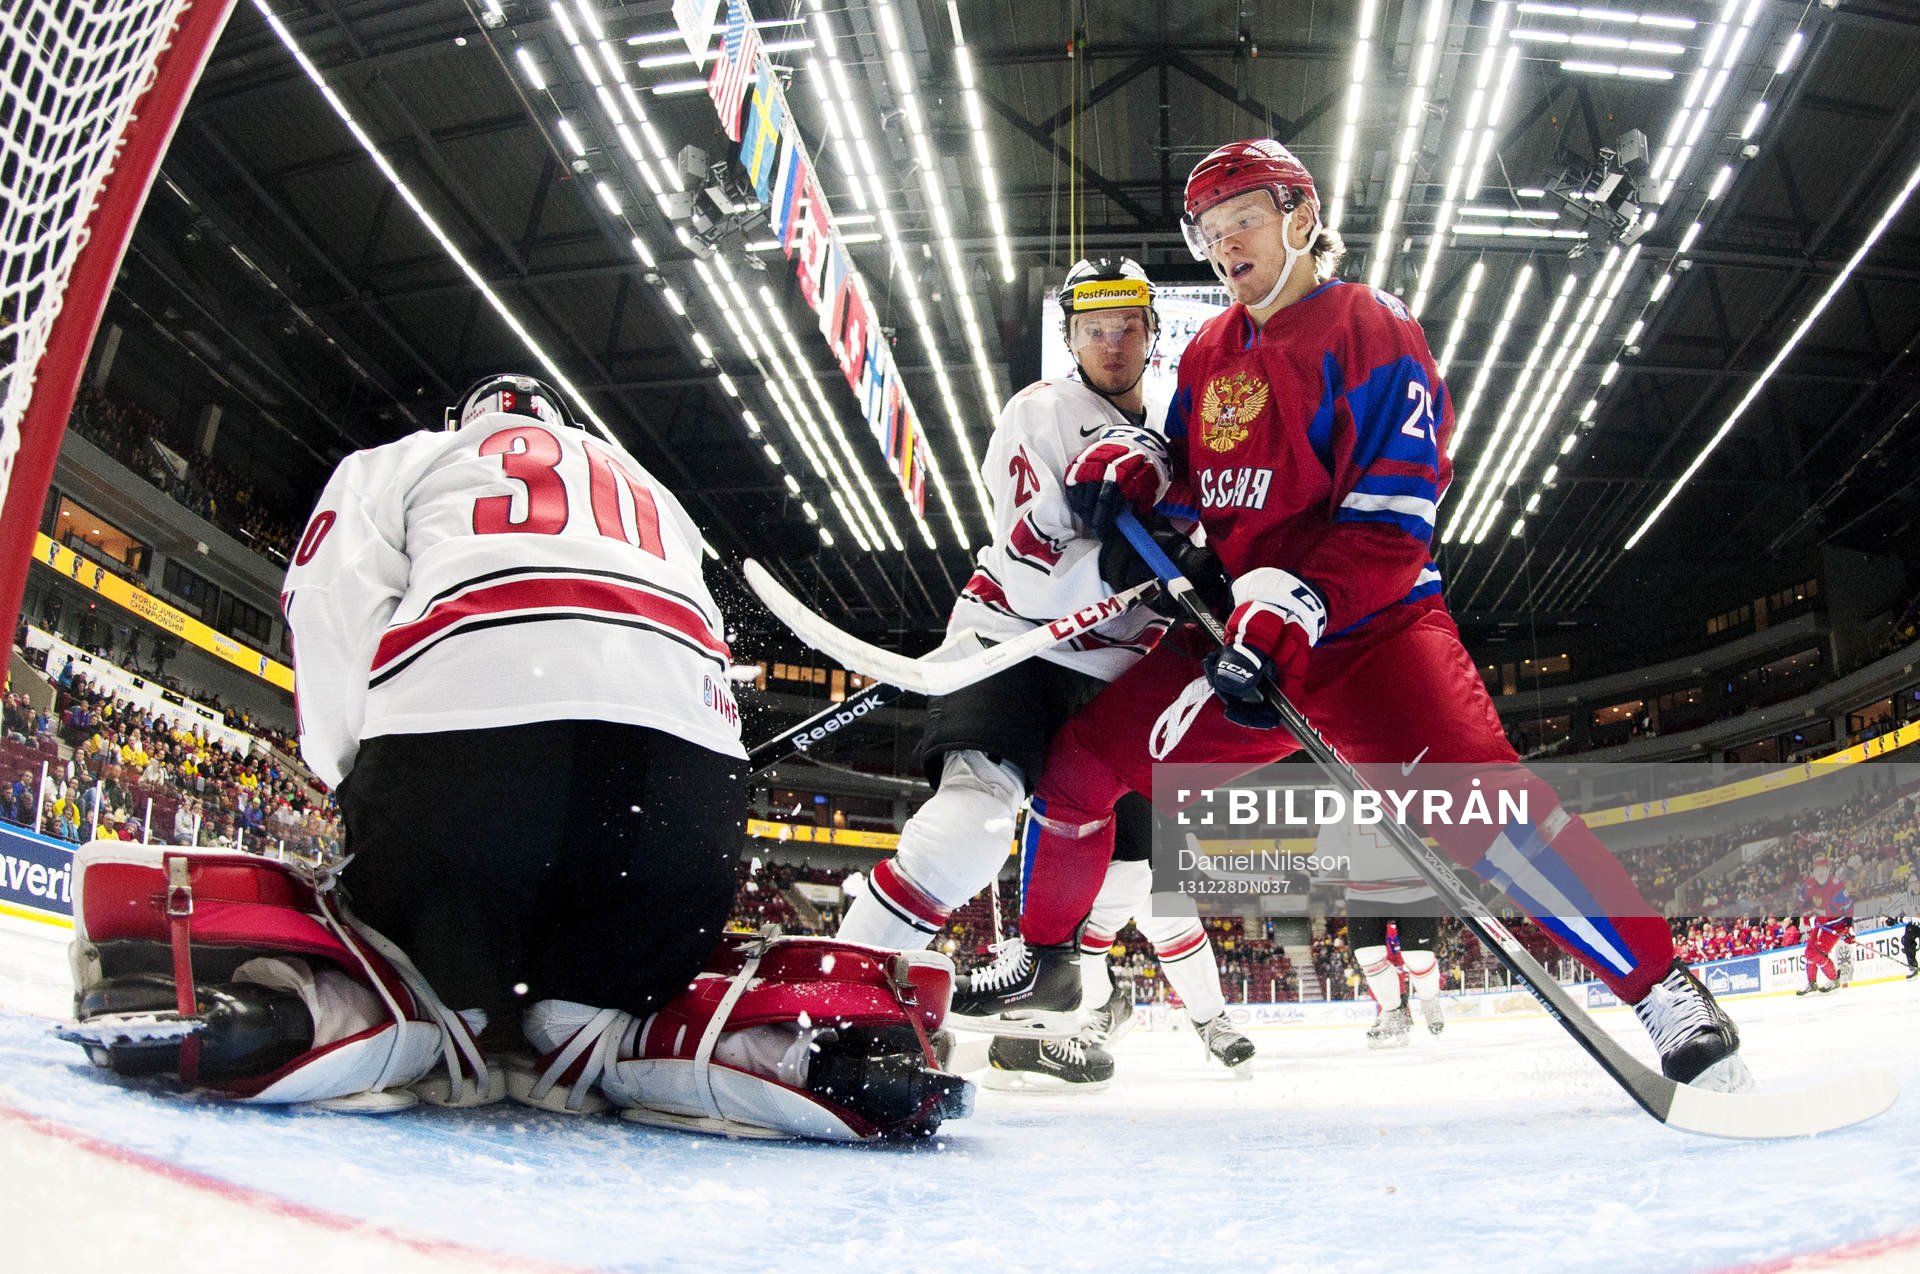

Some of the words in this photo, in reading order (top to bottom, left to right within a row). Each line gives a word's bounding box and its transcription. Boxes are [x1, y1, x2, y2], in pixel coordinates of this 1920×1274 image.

[1077, 288, 1138, 300] PostFinance
[473, 426, 666, 561] 30
[1197, 466, 1273, 510] ССИЯ
[295, 510, 337, 567] 0
[129, 600, 185, 632] CHAMPIONSHIP
[131, 592, 158, 611] WORLD
[159, 607, 186, 624] JUNIOR
[1048, 596, 1123, 641] CCM
[1218, 660, 1254, 679] CCM
[713, 683, 738, 728] IIHF
[791, 694, 885, 752] Reebok
[0, 853, 73, 903] veri
[1876, 936, 1904, 958] TIS
[1004, 991, 1034, 1004] BAUER
